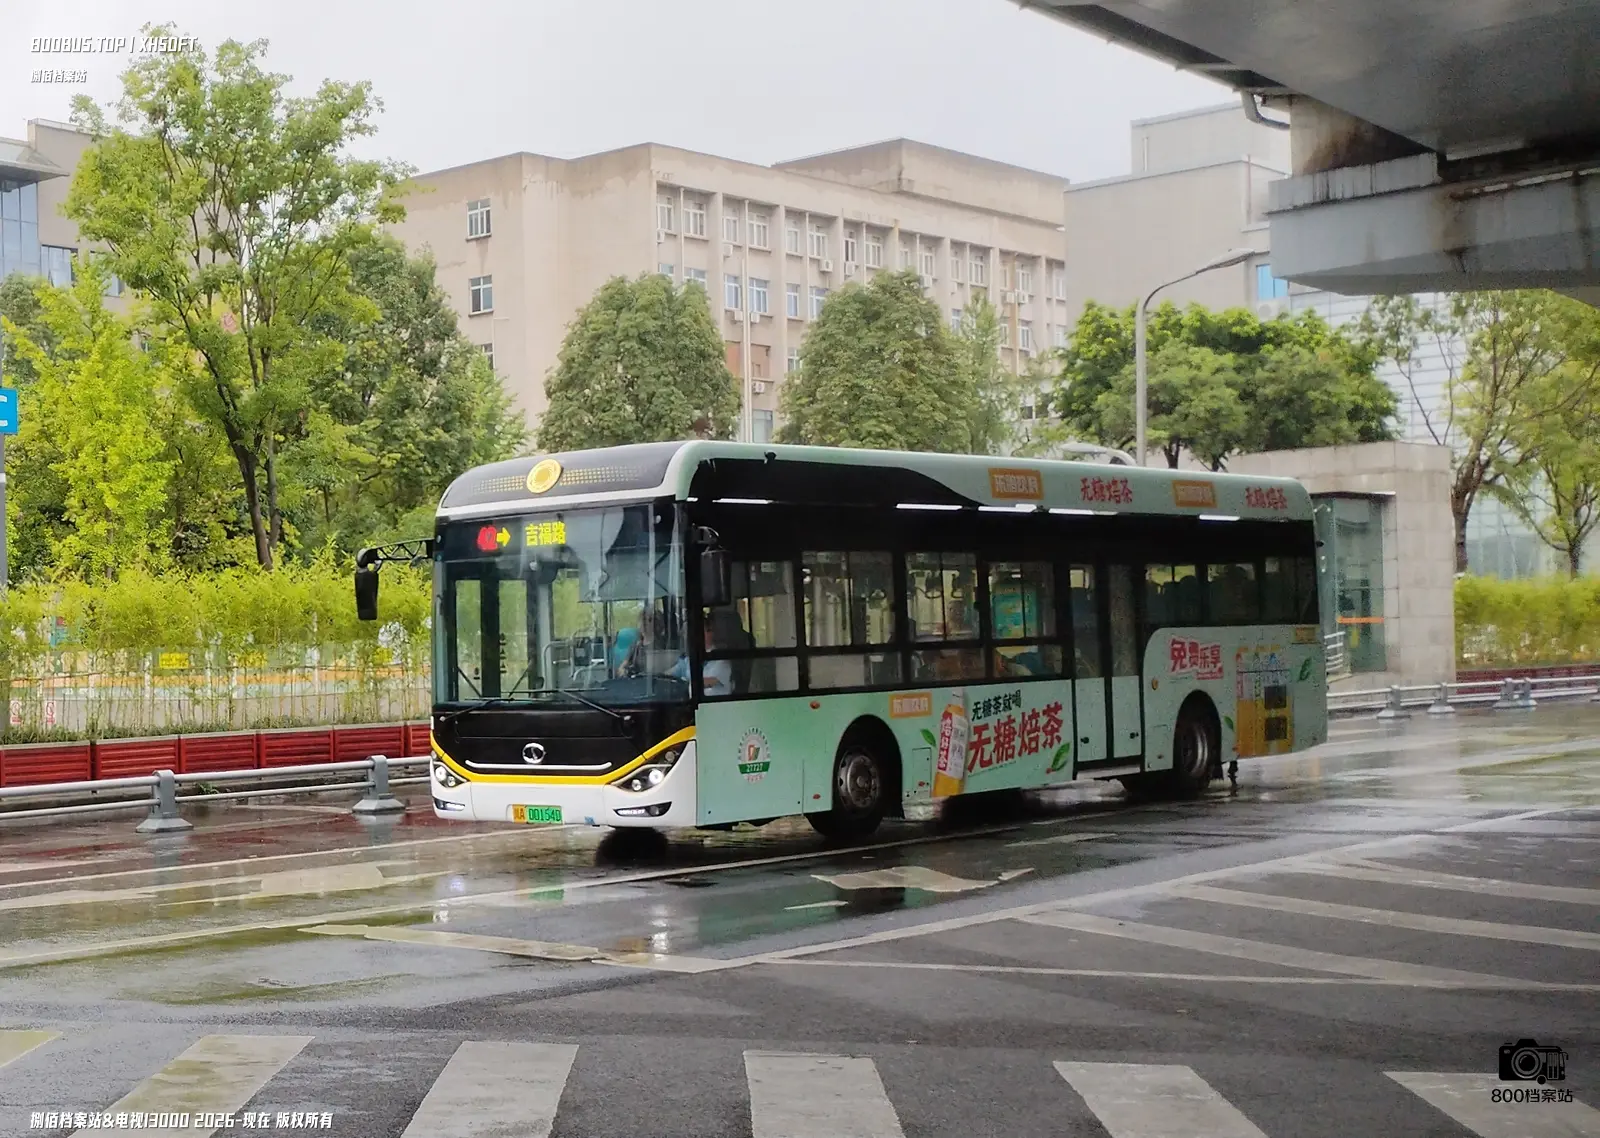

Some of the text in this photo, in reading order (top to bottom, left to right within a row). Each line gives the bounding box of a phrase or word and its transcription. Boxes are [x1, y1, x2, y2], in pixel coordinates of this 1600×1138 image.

[1081, 476, 1133, 504] 无糖焙茶
[972, 689, 1022, 722] 无糖茶就喝
[967, 701, 1063, 773] 无糖焙茶
